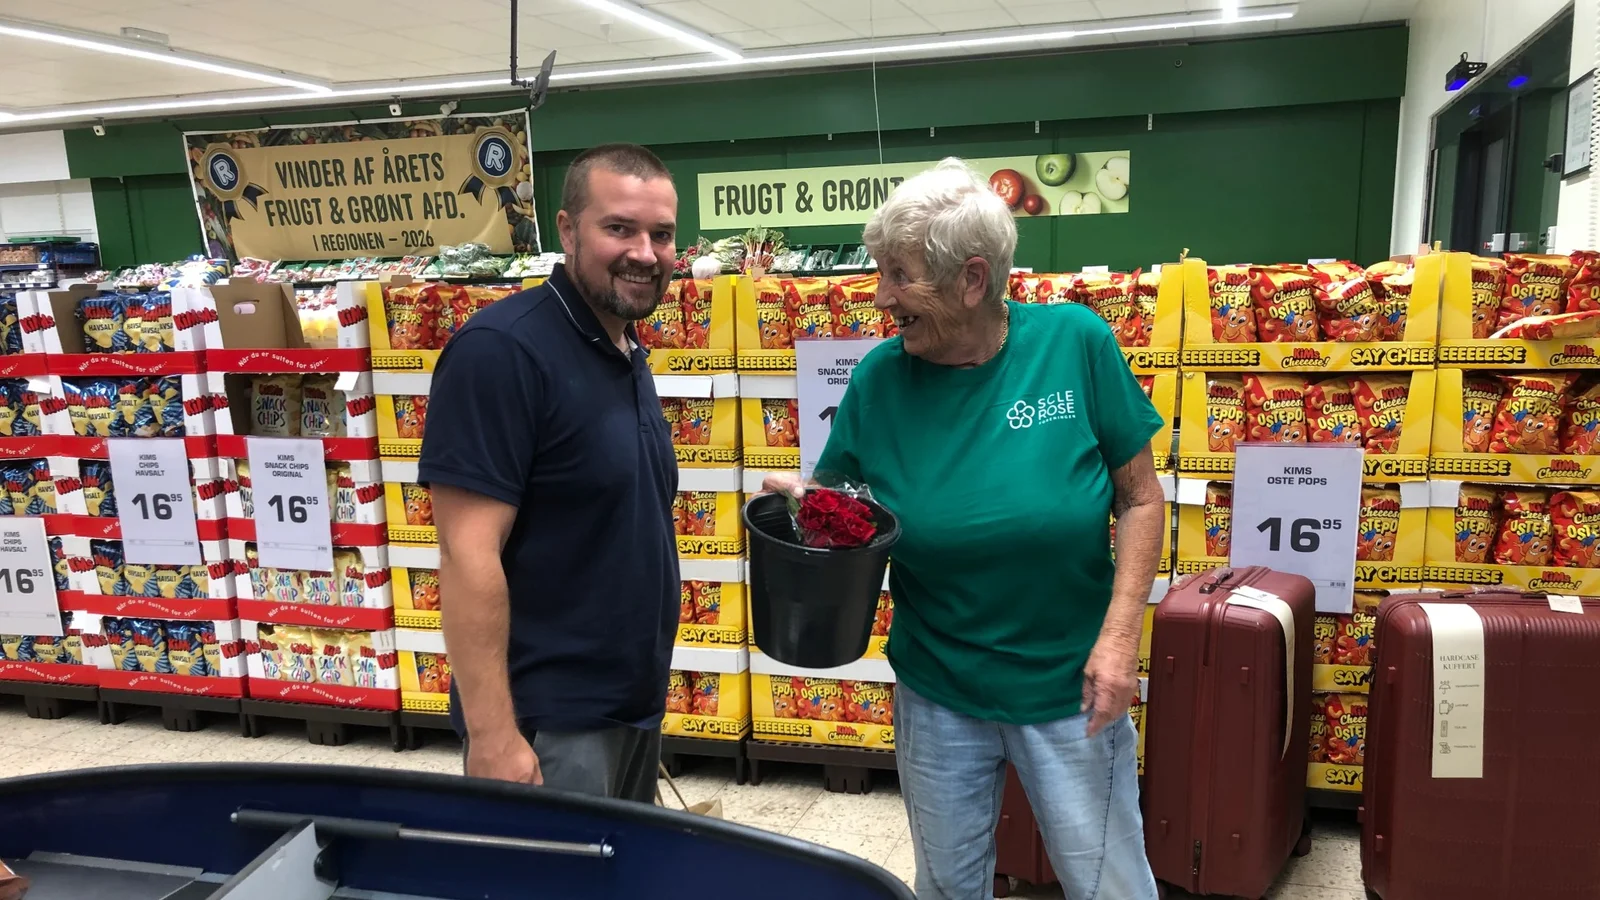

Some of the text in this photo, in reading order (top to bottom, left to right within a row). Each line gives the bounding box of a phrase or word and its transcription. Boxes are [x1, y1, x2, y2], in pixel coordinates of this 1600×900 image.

[275, 147, 445, 189] VINDER AF ÅRETS
[714, 183, 786, 216] FRUGT
[795, 181, 813, 213] &
[264, 191, 466, 227] FRUGT & GRØNT AFD.
[312, 230, 434, 252] I REGIONEN 2026
[88, 323, 114, 331] HAVSALT
[238, 355, 249, 367] Når
[272, 353, 294, 366] sulten
[668, 356, 694, 371] SAY
[835, 358, 859, 366] KIMS
[1350, 348, 1384, 365] SAY
[817, 368, 848, 376] SNACK
[256, 396, 287, 411] SNACK
[1038, 390, 1074, 409] SCLE
[1039, 402, 1075, 420] ROSE
[257, 411, 286, 427] CHIPS
[139, 454, 157, 462] KIMS
[675, 449, 697, 462] SAY
[1283, 466, 1312, 475] KIMS
[1267, 476, 1327, 486] OSTE POPS
[131, 493, 183, 520] 16 95
[268, 495, 319, 523] 16 95
[1256, 517, 1342, 553] 16 95
[678, 540, 703, 554] SAY
[0, 568, 44, 594] 16 95
[1355, 567, 1377, 582] AY
[682, 628, 706, 643] SAY
[1440, 654, 1480, 662] HARDCASE
[1334, 670, 1366, 686] SAY
[682, 718, 704, 732] SAY
[880, 730, 894, 743] SA
[1326, 769, 1359, 785] SAY
